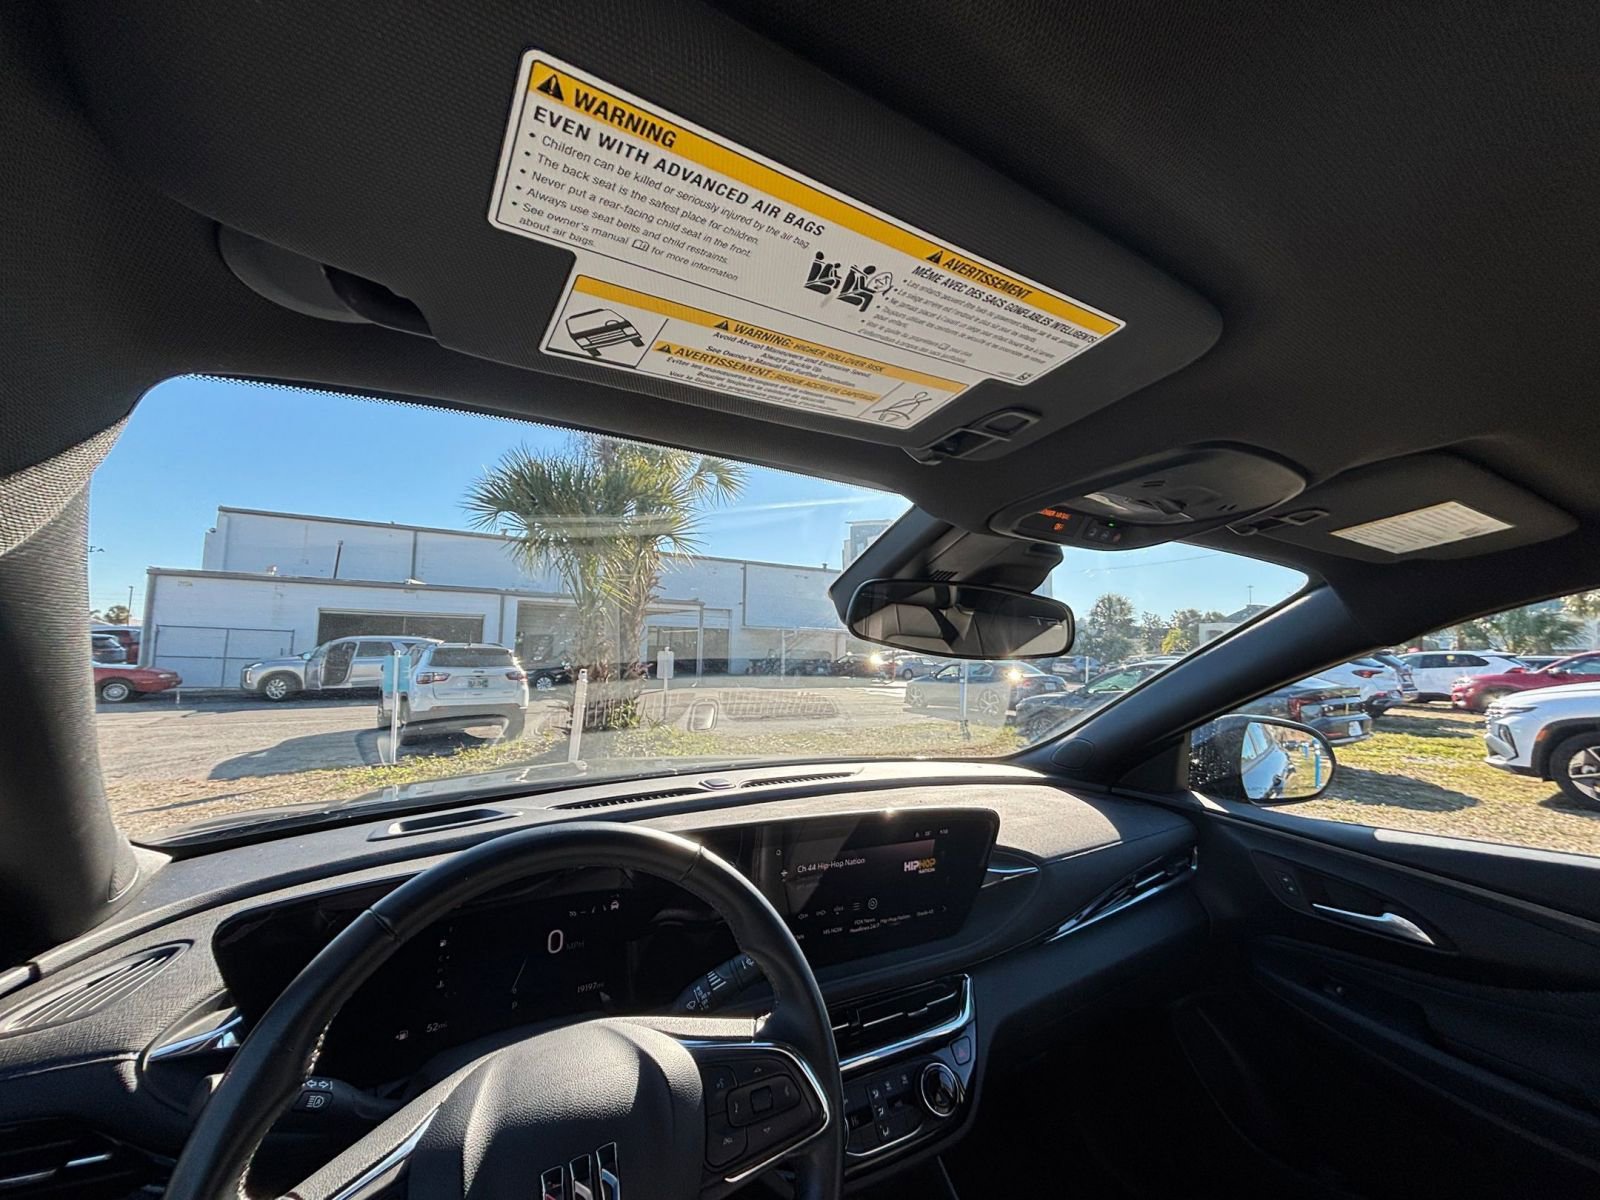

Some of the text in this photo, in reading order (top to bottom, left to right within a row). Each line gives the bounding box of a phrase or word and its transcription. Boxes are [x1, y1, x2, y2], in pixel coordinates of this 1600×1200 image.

[575, 88, 677, 148] WARNING
[533, 105, 825, 236] EVEN WITH ADVANCED AIR BAGS
[538, 153, 559, 170] The
[562, 163, 590, 182] back
[592, 176, 617, 192] seat
[618, 185, 629, 196] is
[630, 190, 647, 203] the
[648, 198, 680, 215] safest
[680, 210, 707, 225] place
[708, 220, 723, 230] for
[542, 135, 591, 163] Children
[593, 158, 615, 172] can
[617, 165, 631, 178] be
[633, 172, 663, 190] killed
[663, 185, 675, 194] or
[675, 190, 720, 214] seriously
[720, 208, 754, 225] injured
[753, 220, 765, 231] by
[765, 225, 780, 236] the
[780, 232, 793, 241] air
[520, 217, 551, 233] about
[552, 228, 567, 237] air
[522, 203, 544, 217] See
[546, 213, 589, 232] owner's
[591, 228, 629, 245] manual
[651, 247, 664, 256] for
[666, 252, 689, 265] more
[526, 188, 567, 208] Always
[570, 204, 589, 215] use
[591, 211, 615, 224] seat
[616, 219, 641, 233] belts
[642, 229, 662, 240] and
[662, 236, 686, 249] child
[532, 171, 566, 190] Never
[567, 186, 587, 198] put
[588, 194, 596, 202] a
[598, 197, 655, 223] rear-facing
[656, 218, 681, 232] child
[680, 227, 702, 239] seat
[703, 234, 712, 243] in
[713, 238, 729, 249] the
[911, 265, 945, 284] MÊME
[940, 278, 968, 293] AVEC
[964, 287, 985, 299] DES
[982, 294, 1007, 308] SACS
[1004, 303, 1054, 326] GONFLABLES
[943, 259, 1033, 299] AVERTISSEMENT
[713, 332, 737, 342] Avoid
[737, 338, 765, 350] Abrupt
[734, 324, 797, 348] WARNING:
[797, 858, 866, 873] Ch 44 Hip-Hop Nation
[547, 929, 564, 954] 0
